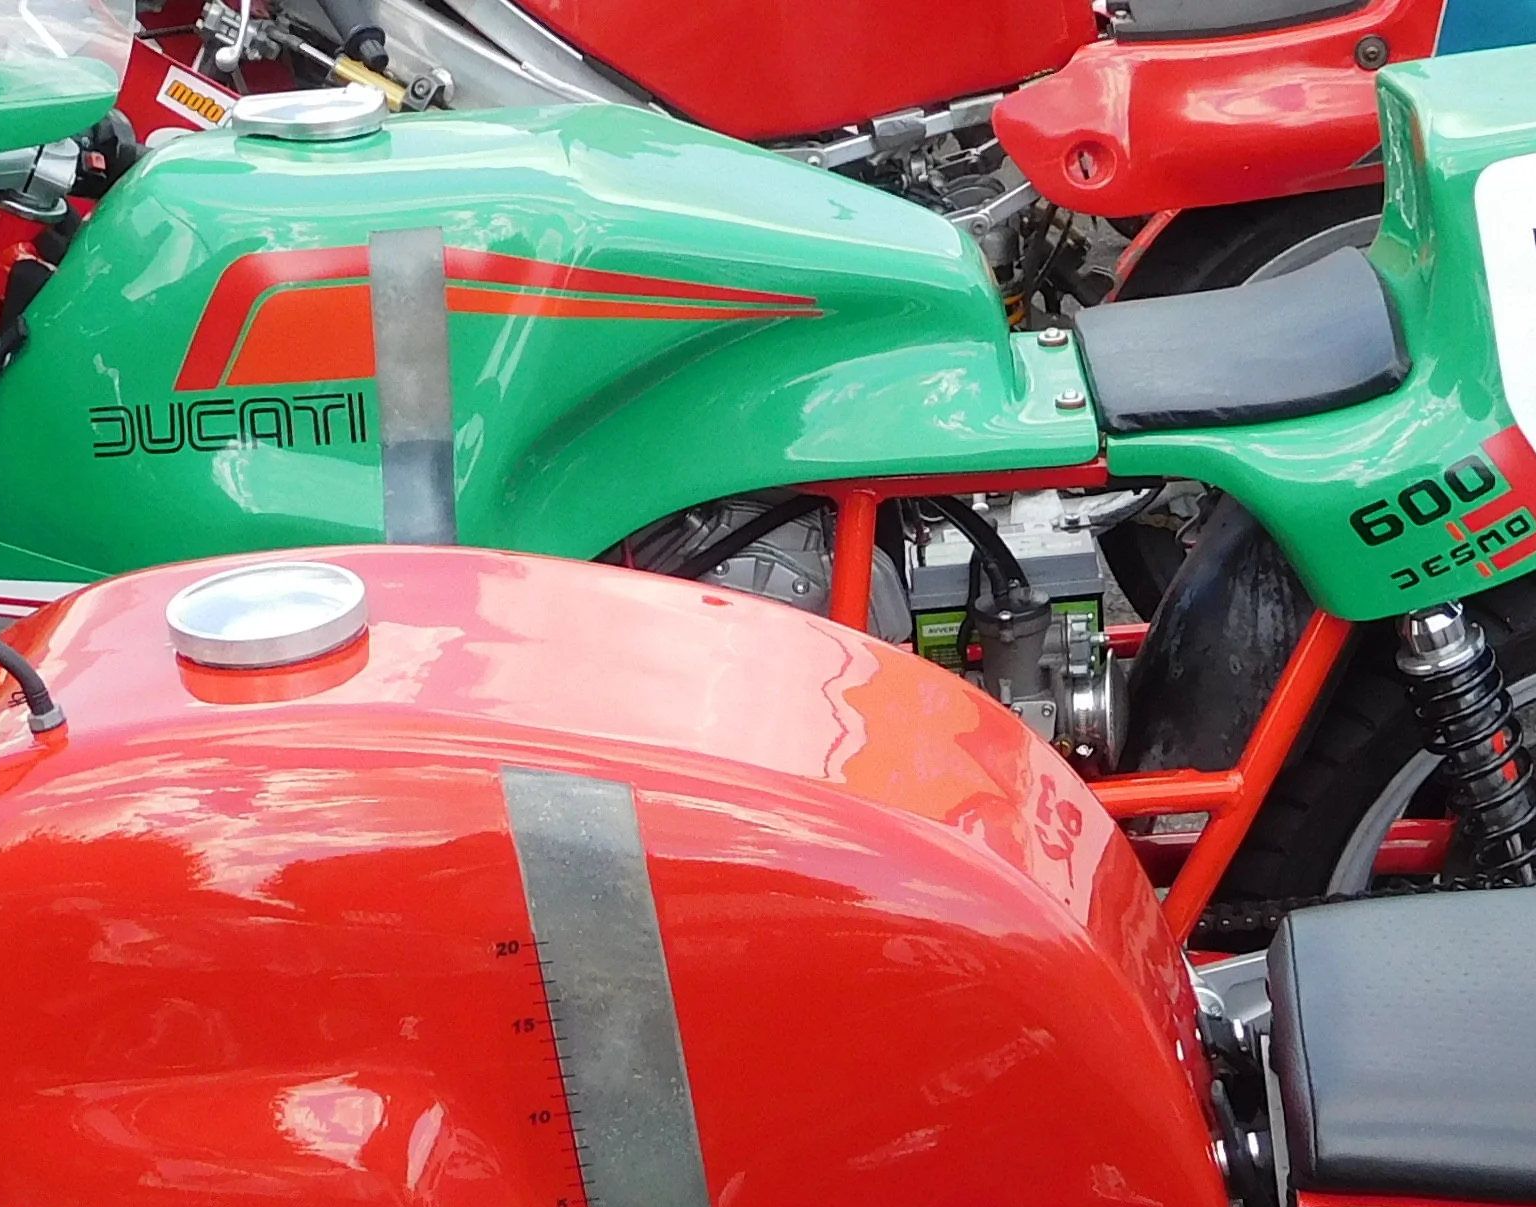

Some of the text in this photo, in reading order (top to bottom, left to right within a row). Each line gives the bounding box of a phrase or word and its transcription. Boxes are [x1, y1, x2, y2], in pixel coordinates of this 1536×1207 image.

[165, 79, 232, 127] moto
[89, 392, 367, 458] DUCATI
[1349, 455, 1496, 547] 600
[1390, 514, 1530, 590] DESMO
[927, 625, 960, 635] AVVERT
[496, 939, 520, 958] 20
[512, 1018, 535, 1034] 15
[529, 1110, 551, 1126] 10
